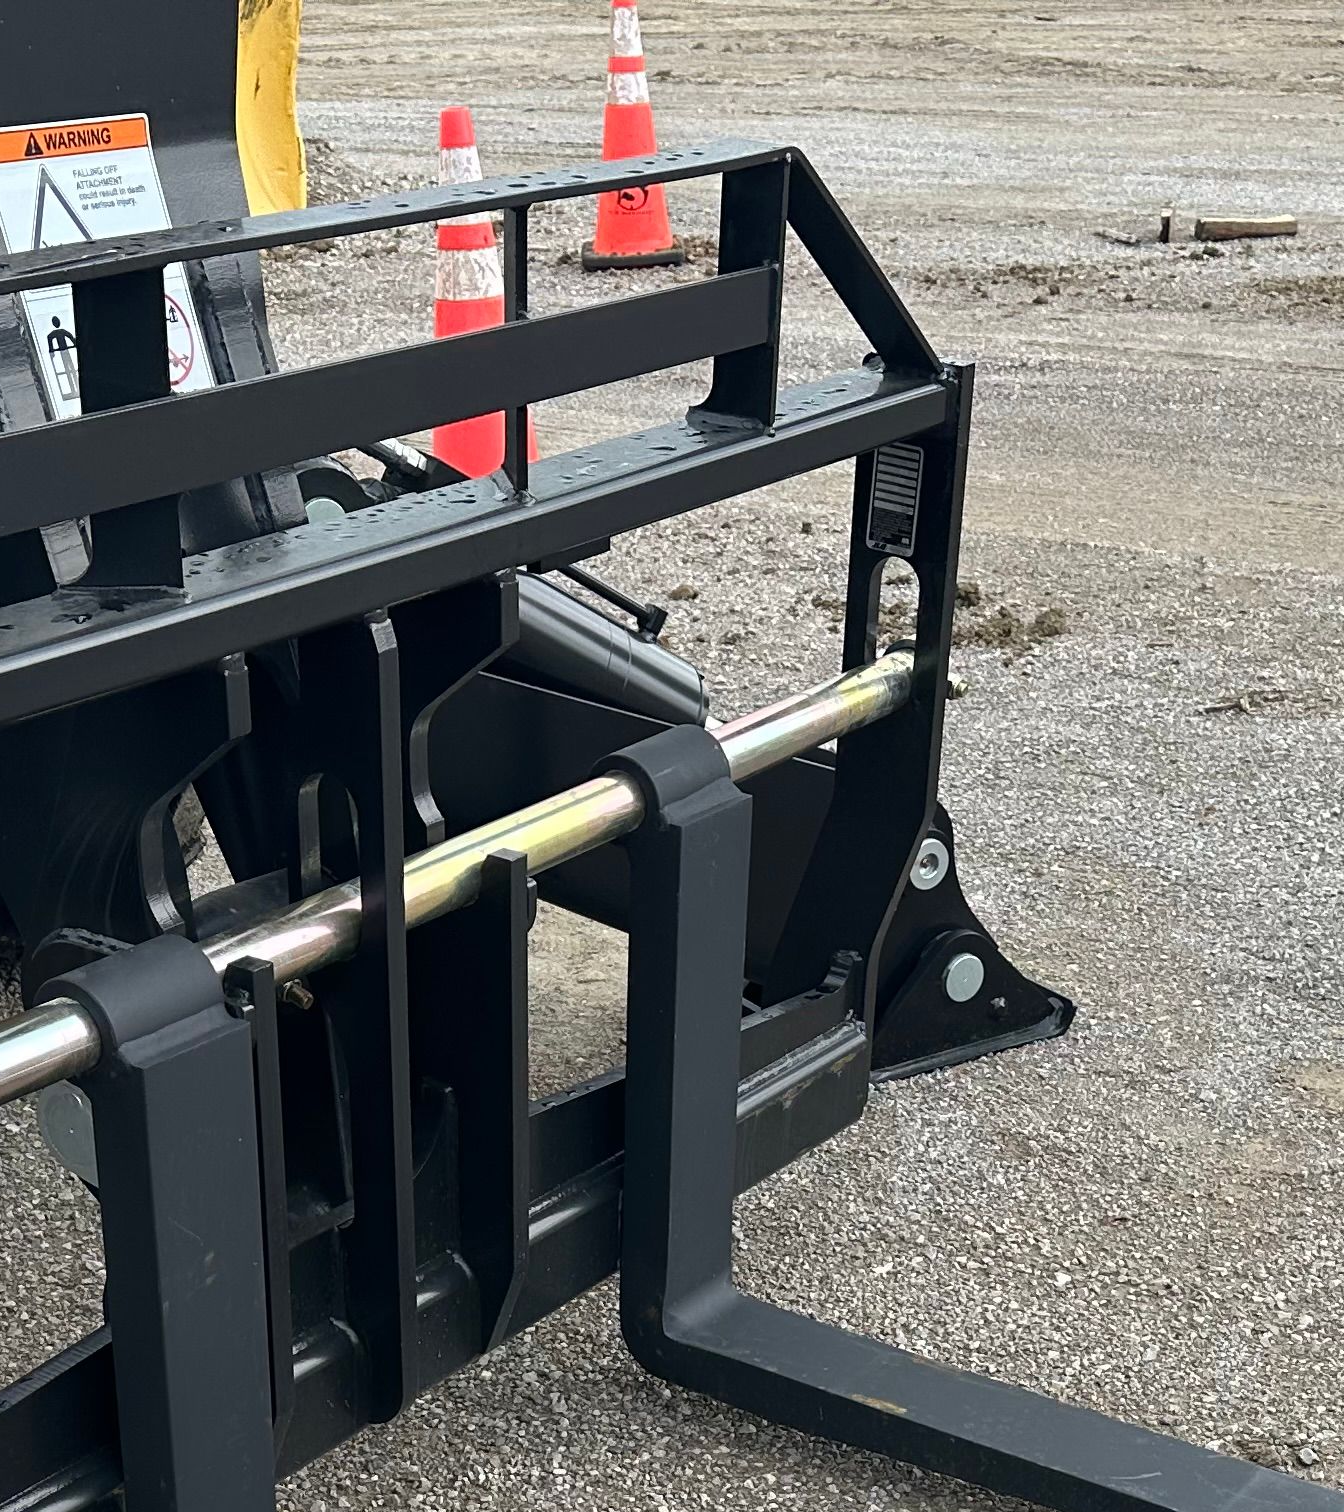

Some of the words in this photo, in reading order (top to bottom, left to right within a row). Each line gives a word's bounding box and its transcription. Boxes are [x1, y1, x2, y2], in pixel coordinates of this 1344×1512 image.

[43, 127, 111, 151] WARNING
[72, 167, 103, 178] FALLING
[104, 165, 118, 174] OFF
[76, 176, 123, 190] ATTACHMENT
[79, 190, 98, 200] could
[99, 187, 118, 198] result
[119, 187, 126, 195] in
[127, 184, 146, 195] death
